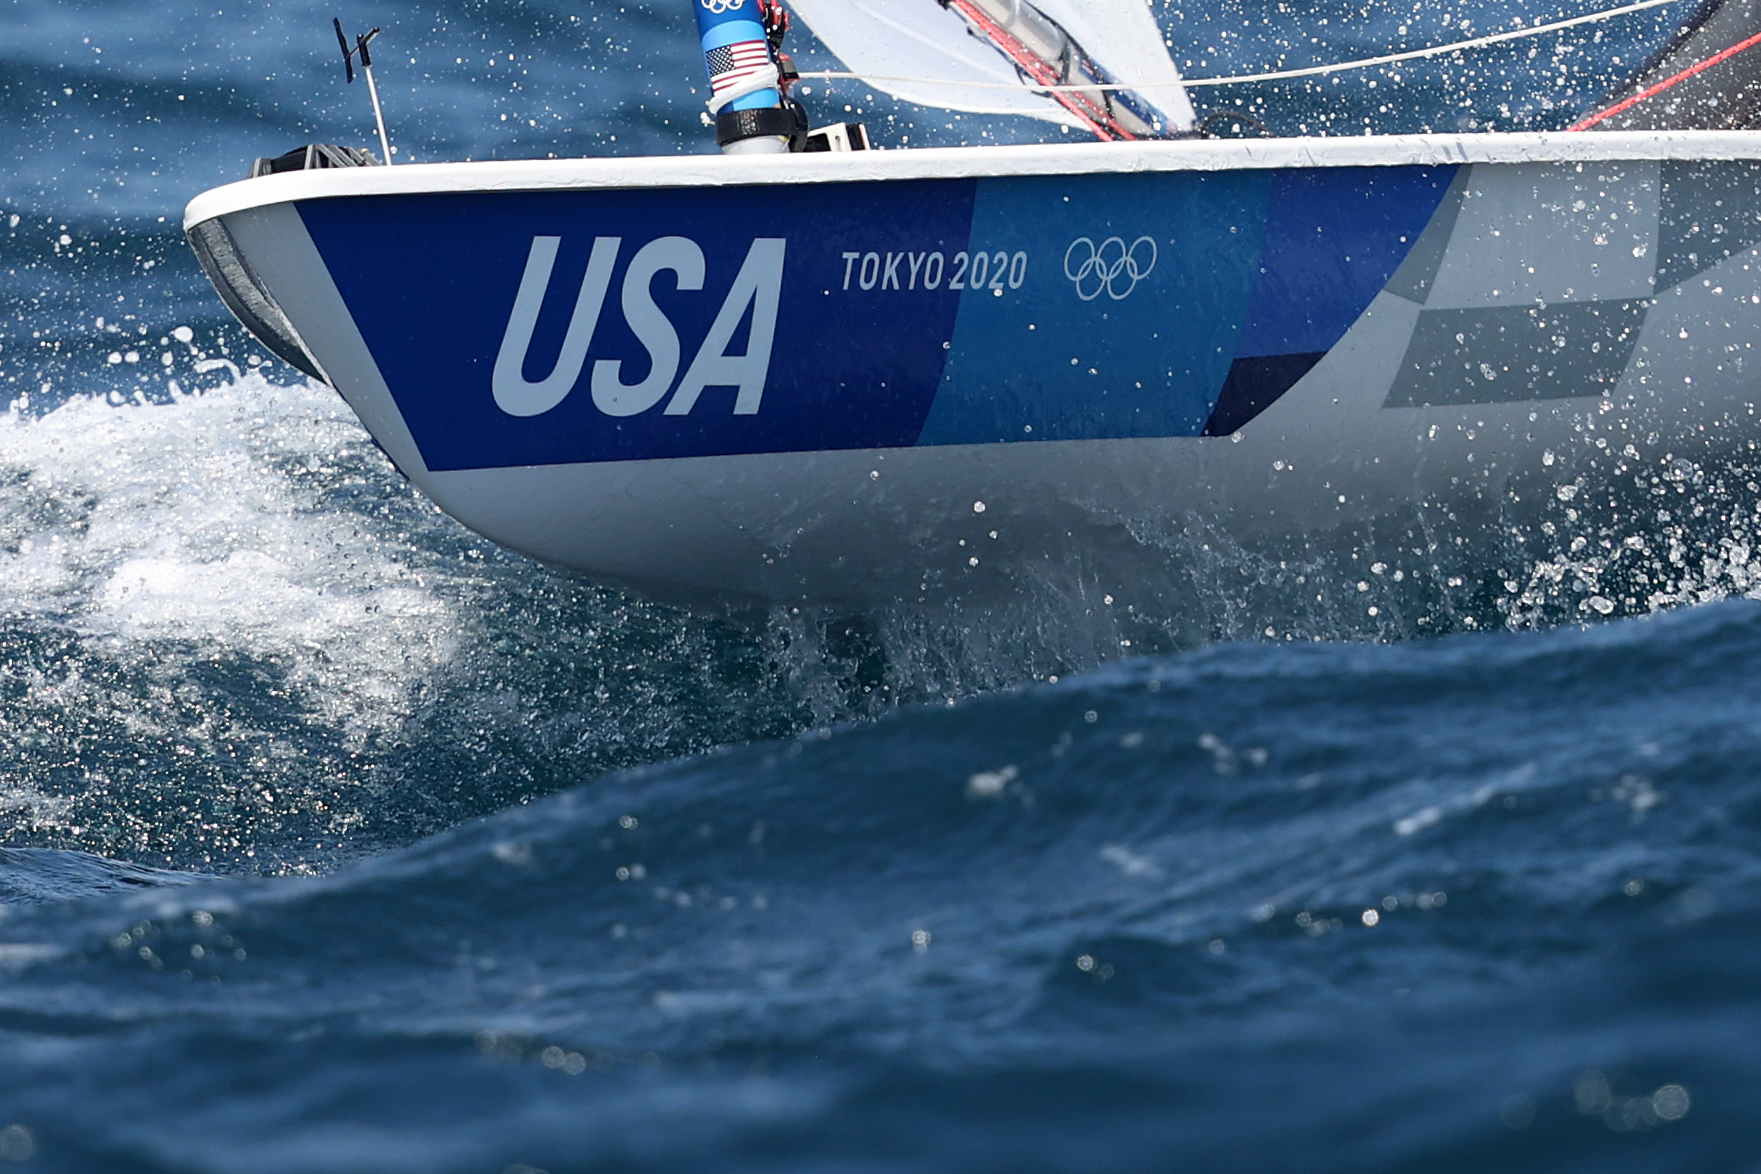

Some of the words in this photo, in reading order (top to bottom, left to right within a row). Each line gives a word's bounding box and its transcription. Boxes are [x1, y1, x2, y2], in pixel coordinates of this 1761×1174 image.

[842, 251, 945, 290] TOKYO
[949, 251, 1028, 290] 2020
[491, 235, 786, 417] USA
